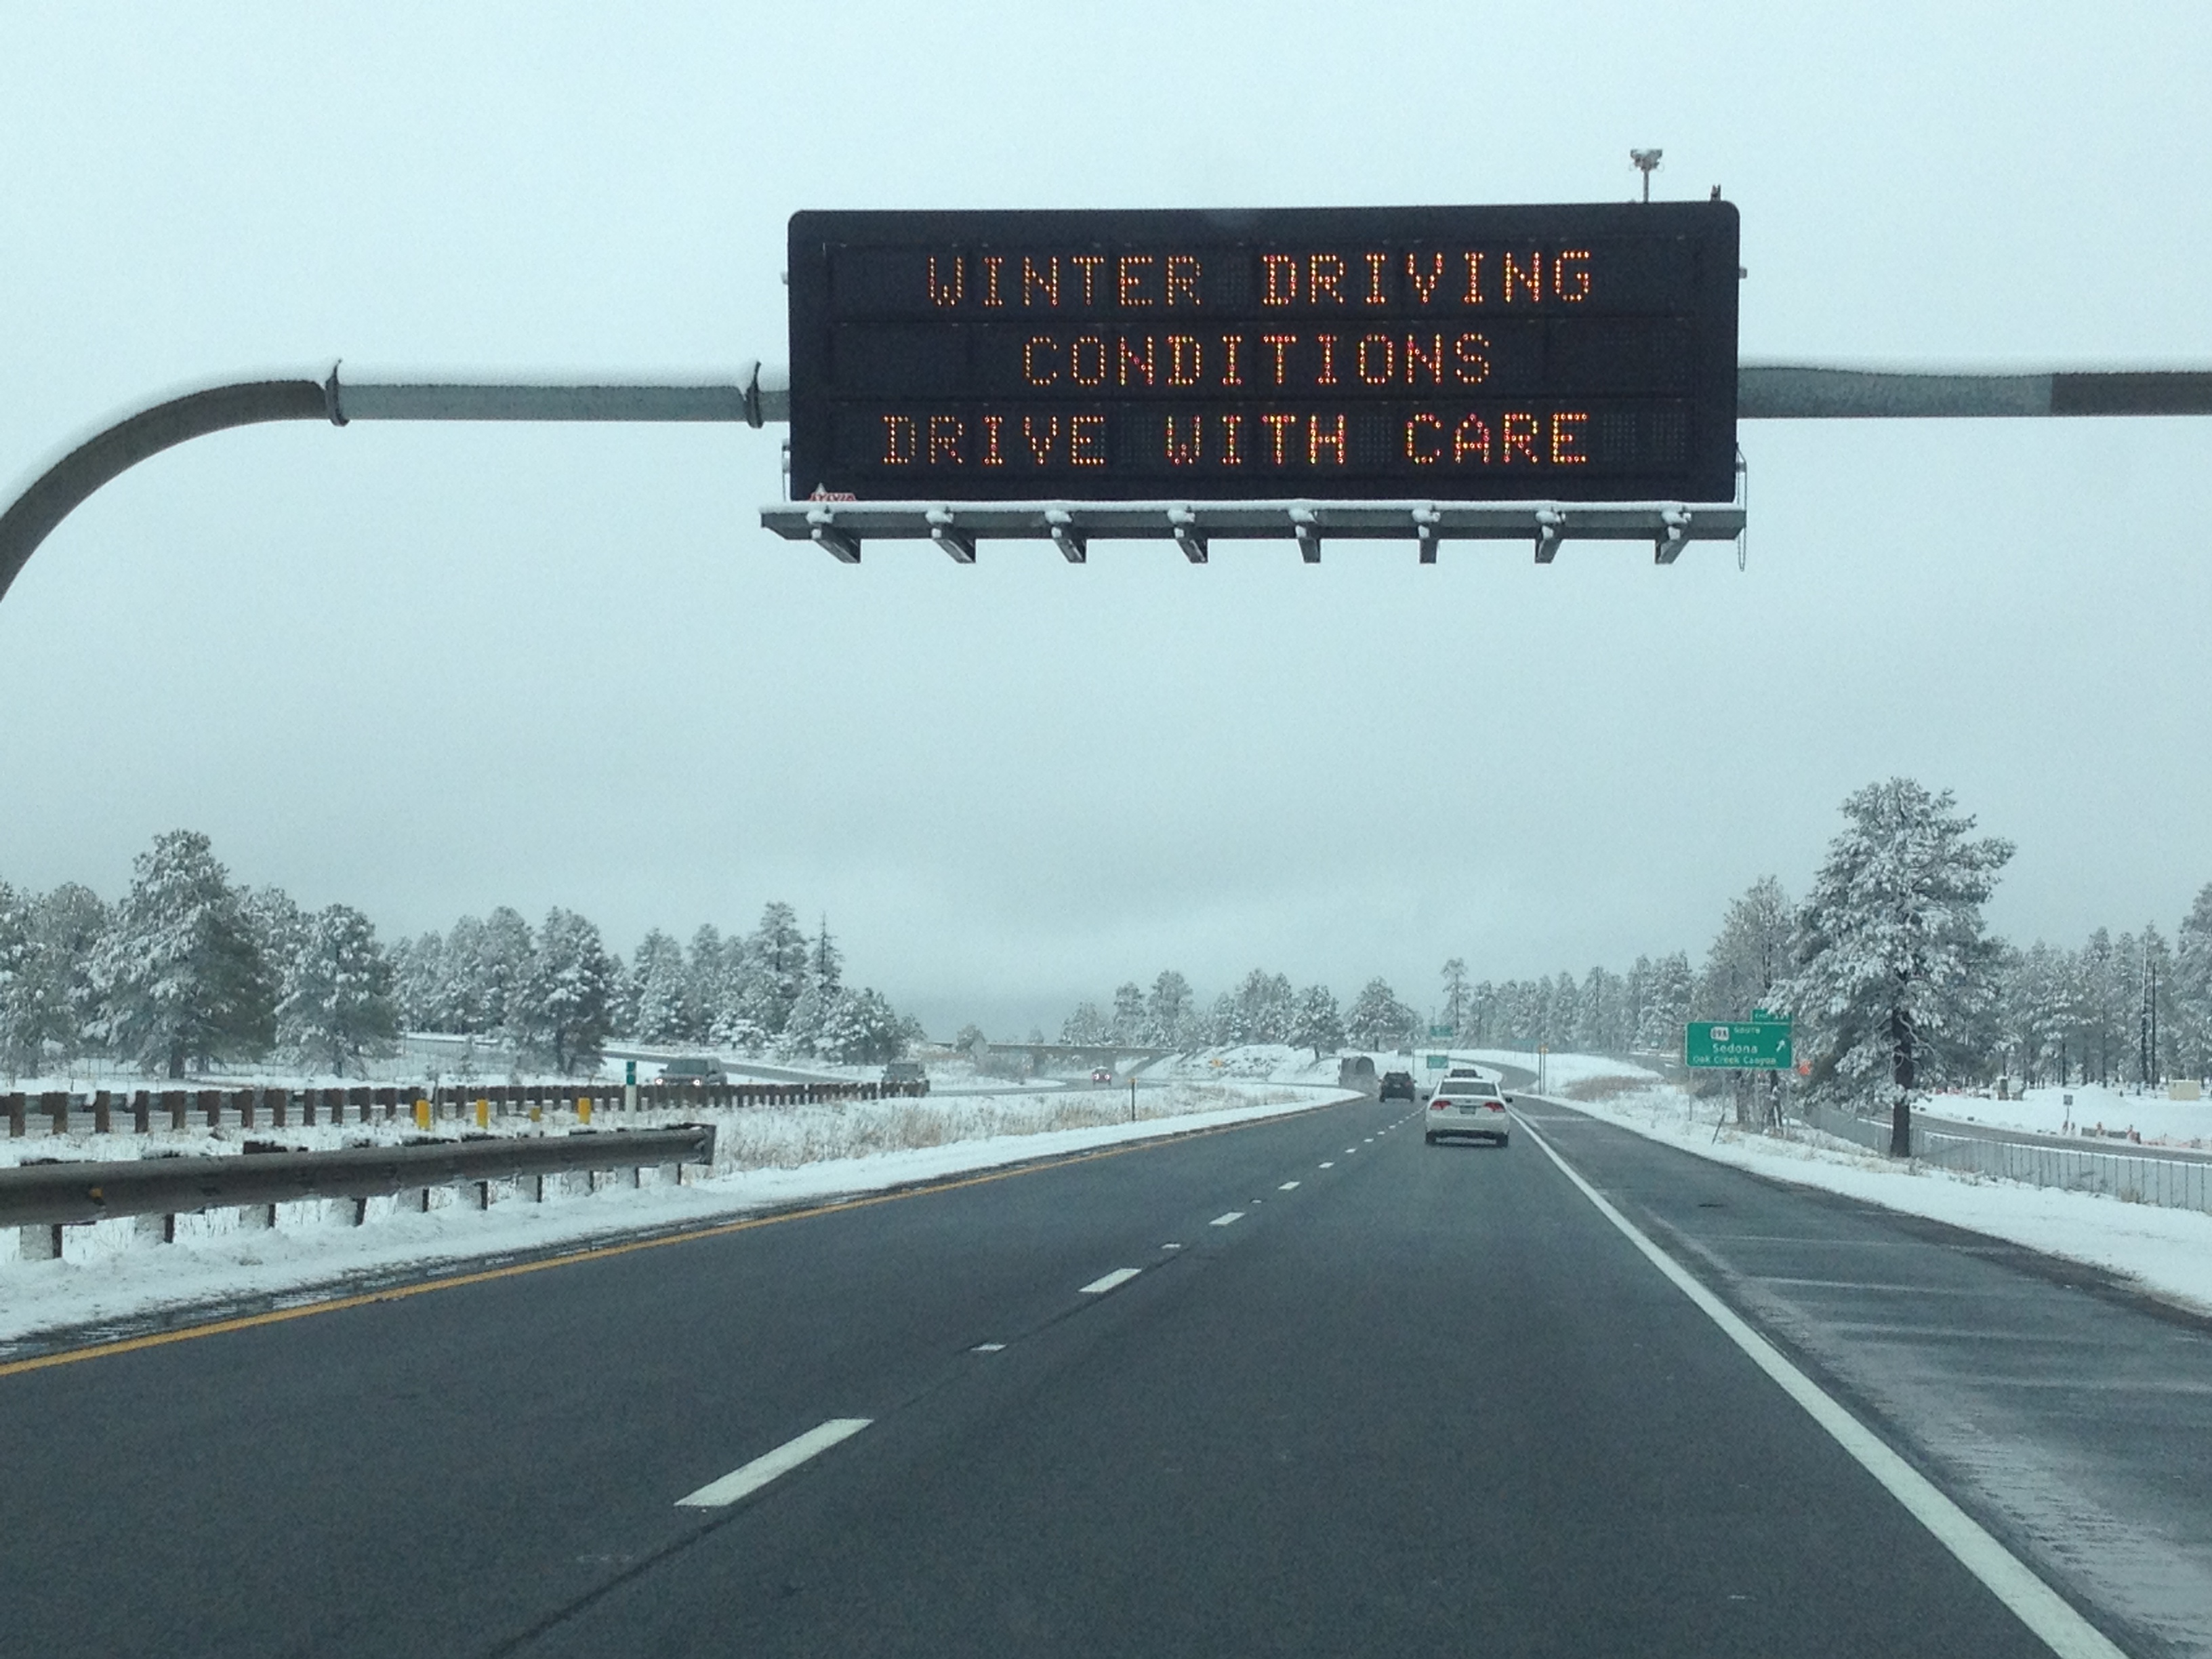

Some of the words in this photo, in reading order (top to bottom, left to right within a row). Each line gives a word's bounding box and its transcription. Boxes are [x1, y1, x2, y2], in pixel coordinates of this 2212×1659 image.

[927, 255, 1202, 306] WINTER
[1262, 251, 1590, 304] DRIVING
[1023, 334, 1490, 386] CONDITIONS
[883, 414, 1107, 465] DRIVE
[1166, 414, 1345, 465] WITH
[1406, 412, 1589, 464] CARE
[1713, 1043, 1758, 1054] Sedona
[1714, 1056, 1740, 1064] Creek
[1743, 1057, 1776, 1065] Canyon
